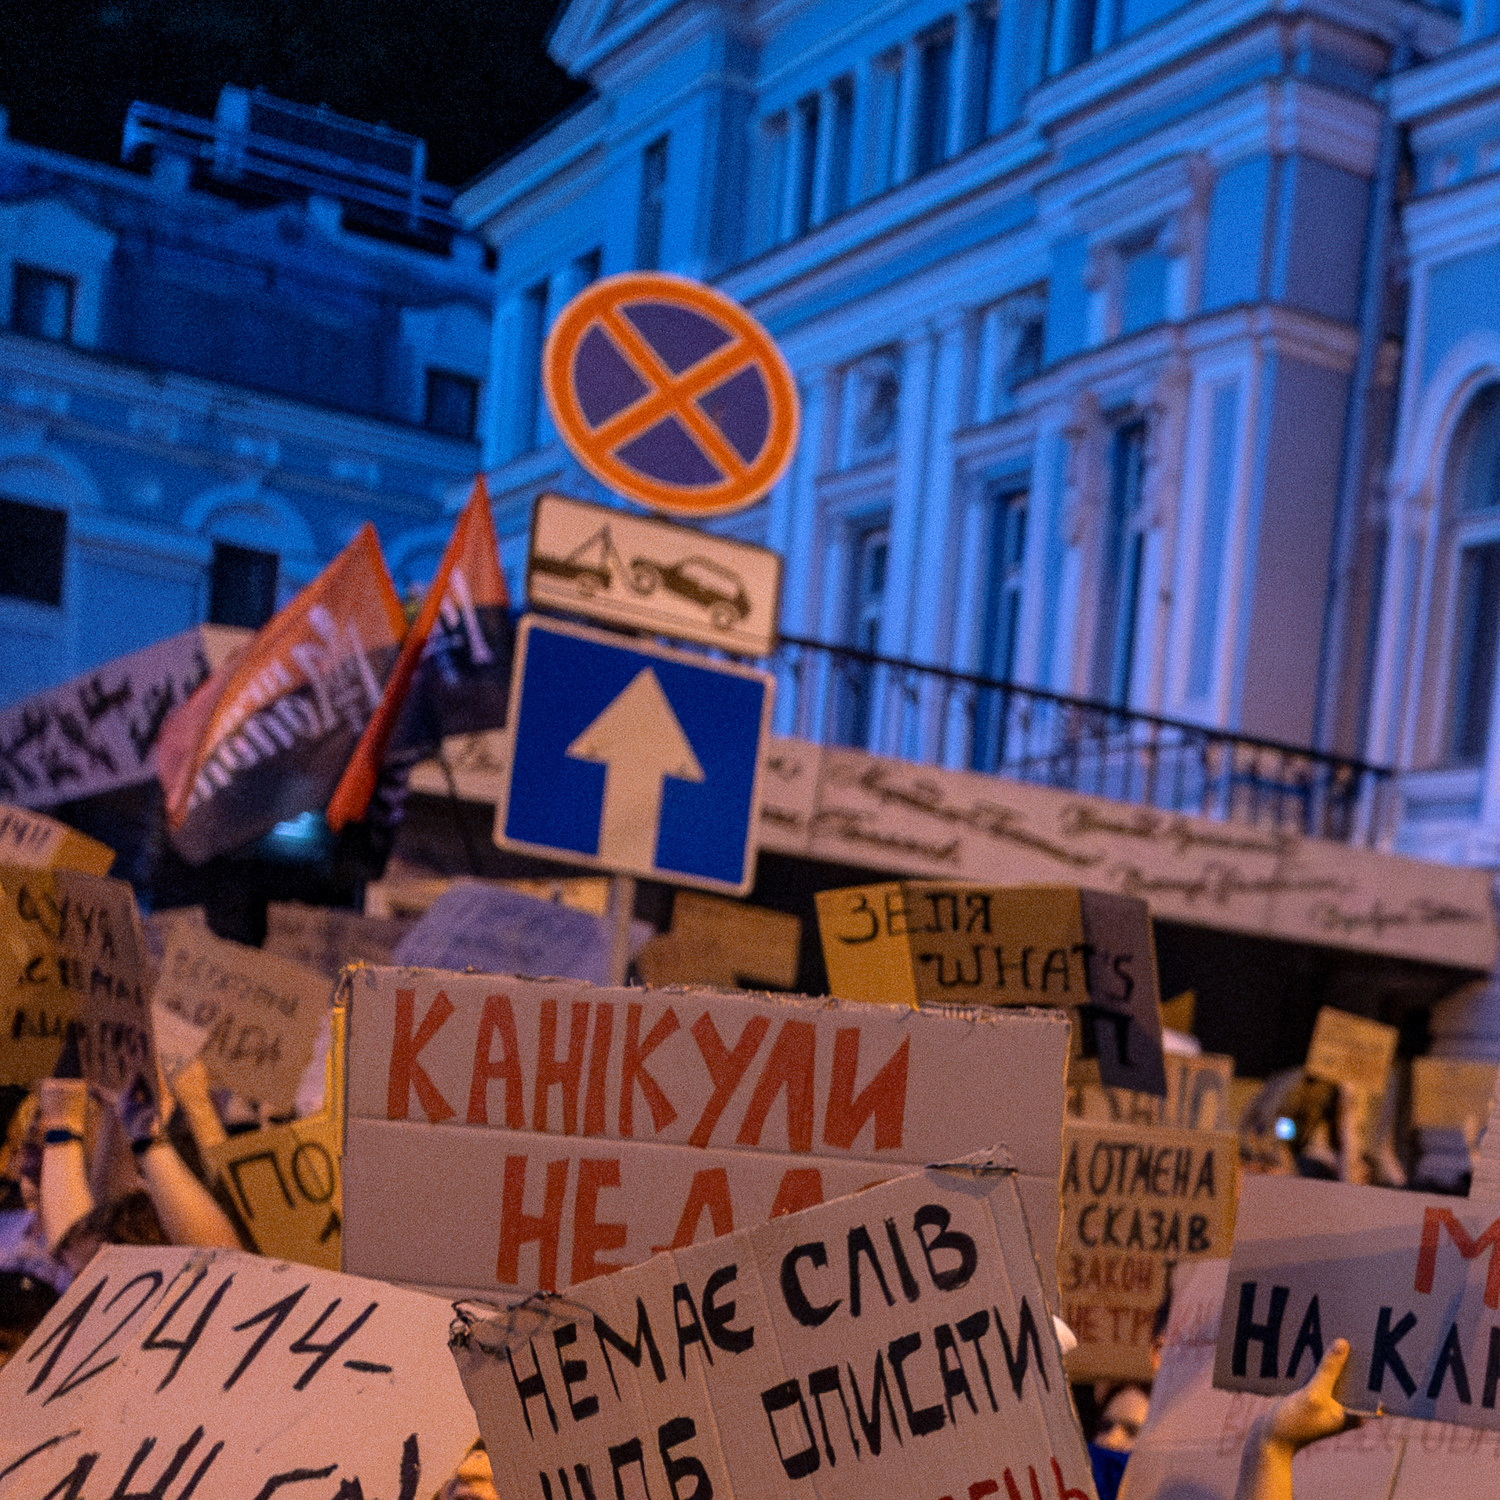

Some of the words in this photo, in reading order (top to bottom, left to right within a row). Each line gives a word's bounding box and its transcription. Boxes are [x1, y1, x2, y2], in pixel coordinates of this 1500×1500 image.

[387, 987, 911, 1155] КАНІКУЛИ
[497, 1155, 627, 1293] НЕ
[780, 1203, 977, 1326] СЛІВ
[1078, 1204, 1210, 1252] СКАЗАВ
[761, 1295, 1051, 1479] ОПИСАТИ
[1231, 1281, 1323, 1380] НА
